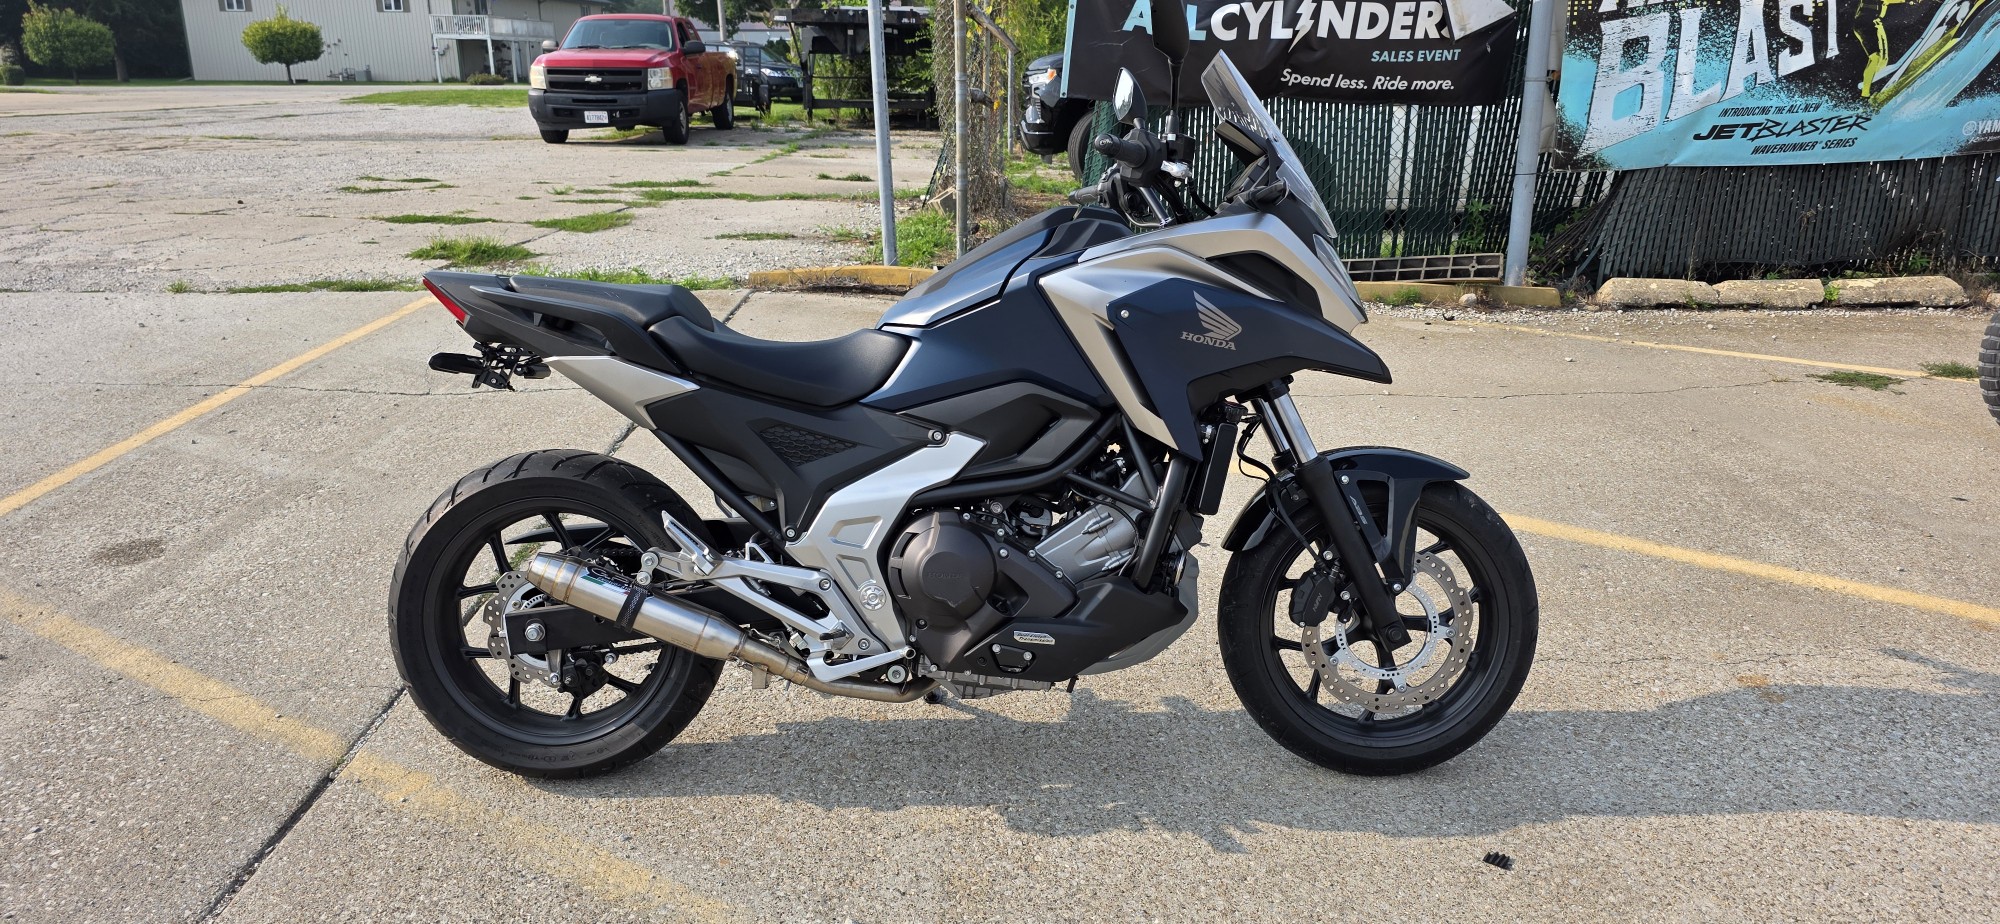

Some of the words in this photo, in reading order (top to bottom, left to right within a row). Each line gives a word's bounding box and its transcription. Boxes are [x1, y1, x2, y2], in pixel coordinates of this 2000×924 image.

[1370, 50, 1414, 62] SALES
[1417, 49, 1461, 62] EVENT
[1280, 68, 1335, 87] Spend
[1335, 74, 1368, 89] less.
[1372, 75, 1408, 90] Ride
[1411, 79, 1455, 90] more.
[1718, 105, 1771, 118] INTRODUCING
[1774, 106, 1786, 115] THE
[1786, 103, 1824, 114] ALL-NEW
[1822, 137, 1858, 150] SERIES
[1180, 331, 1237, 350] HONDA
